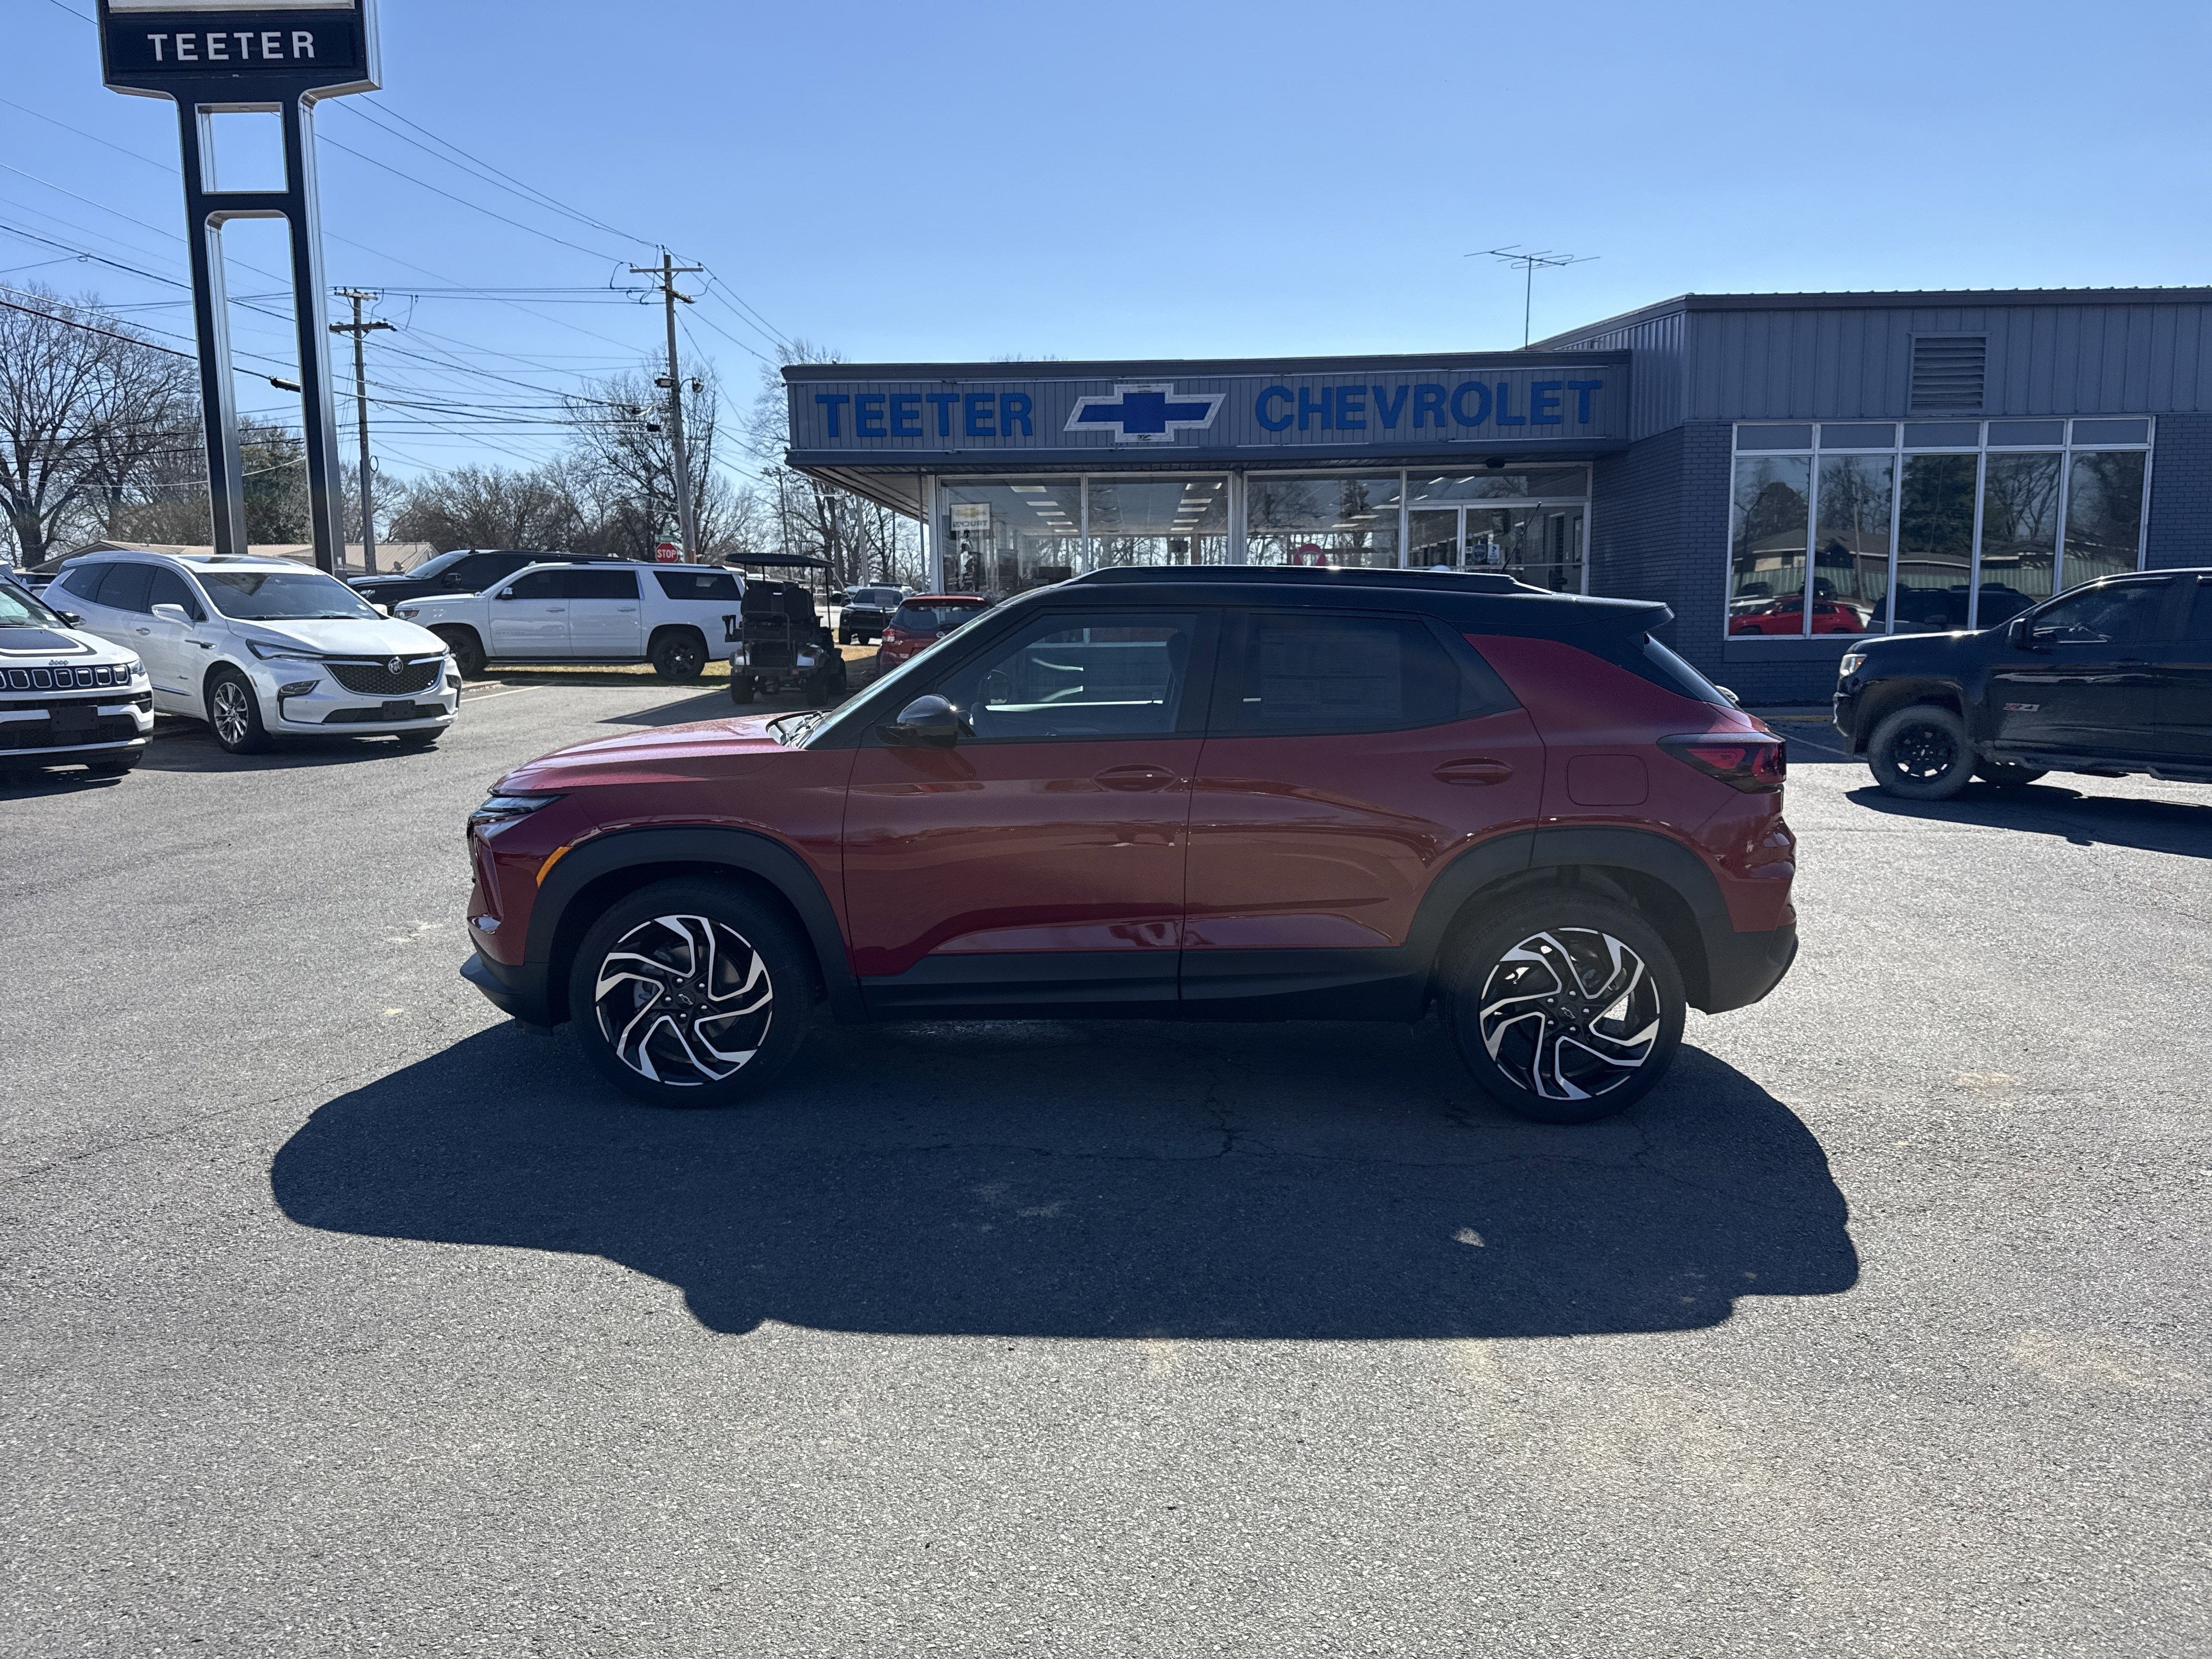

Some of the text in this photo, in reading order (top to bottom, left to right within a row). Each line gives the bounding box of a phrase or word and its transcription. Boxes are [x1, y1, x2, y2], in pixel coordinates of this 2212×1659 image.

[147, 31, 315, 61] TEETER
[815, 379, 1602, 438] TEETER CHEVROLET
[657, 549, 676, 558] STOP
